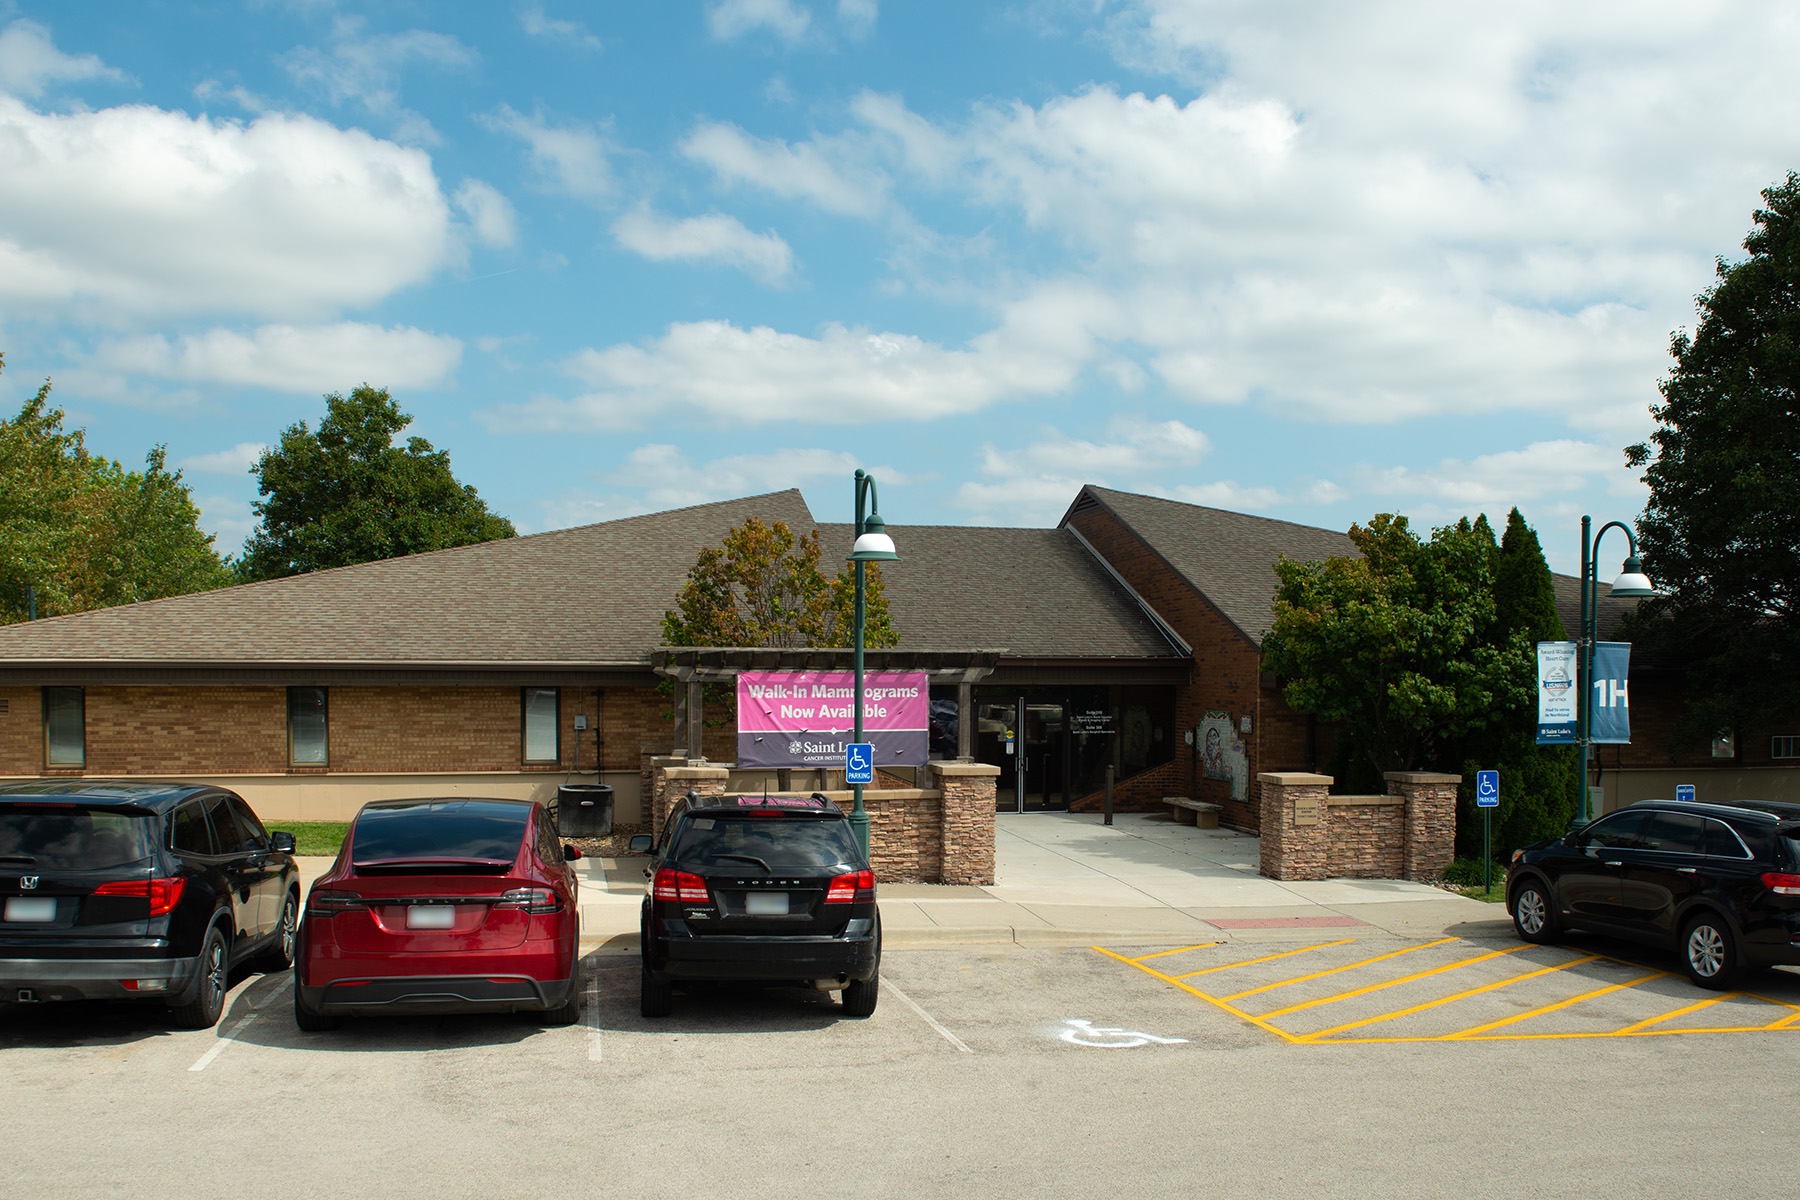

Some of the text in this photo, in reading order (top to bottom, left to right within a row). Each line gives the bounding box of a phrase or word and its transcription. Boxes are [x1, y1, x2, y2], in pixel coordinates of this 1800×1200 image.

[749, 684, 807, 698] Walk-In
[1594, 679, 1628, 707] 1H
[781, 703, 887, 718] Now Availble
[803, 741, 836, 753] Saint
